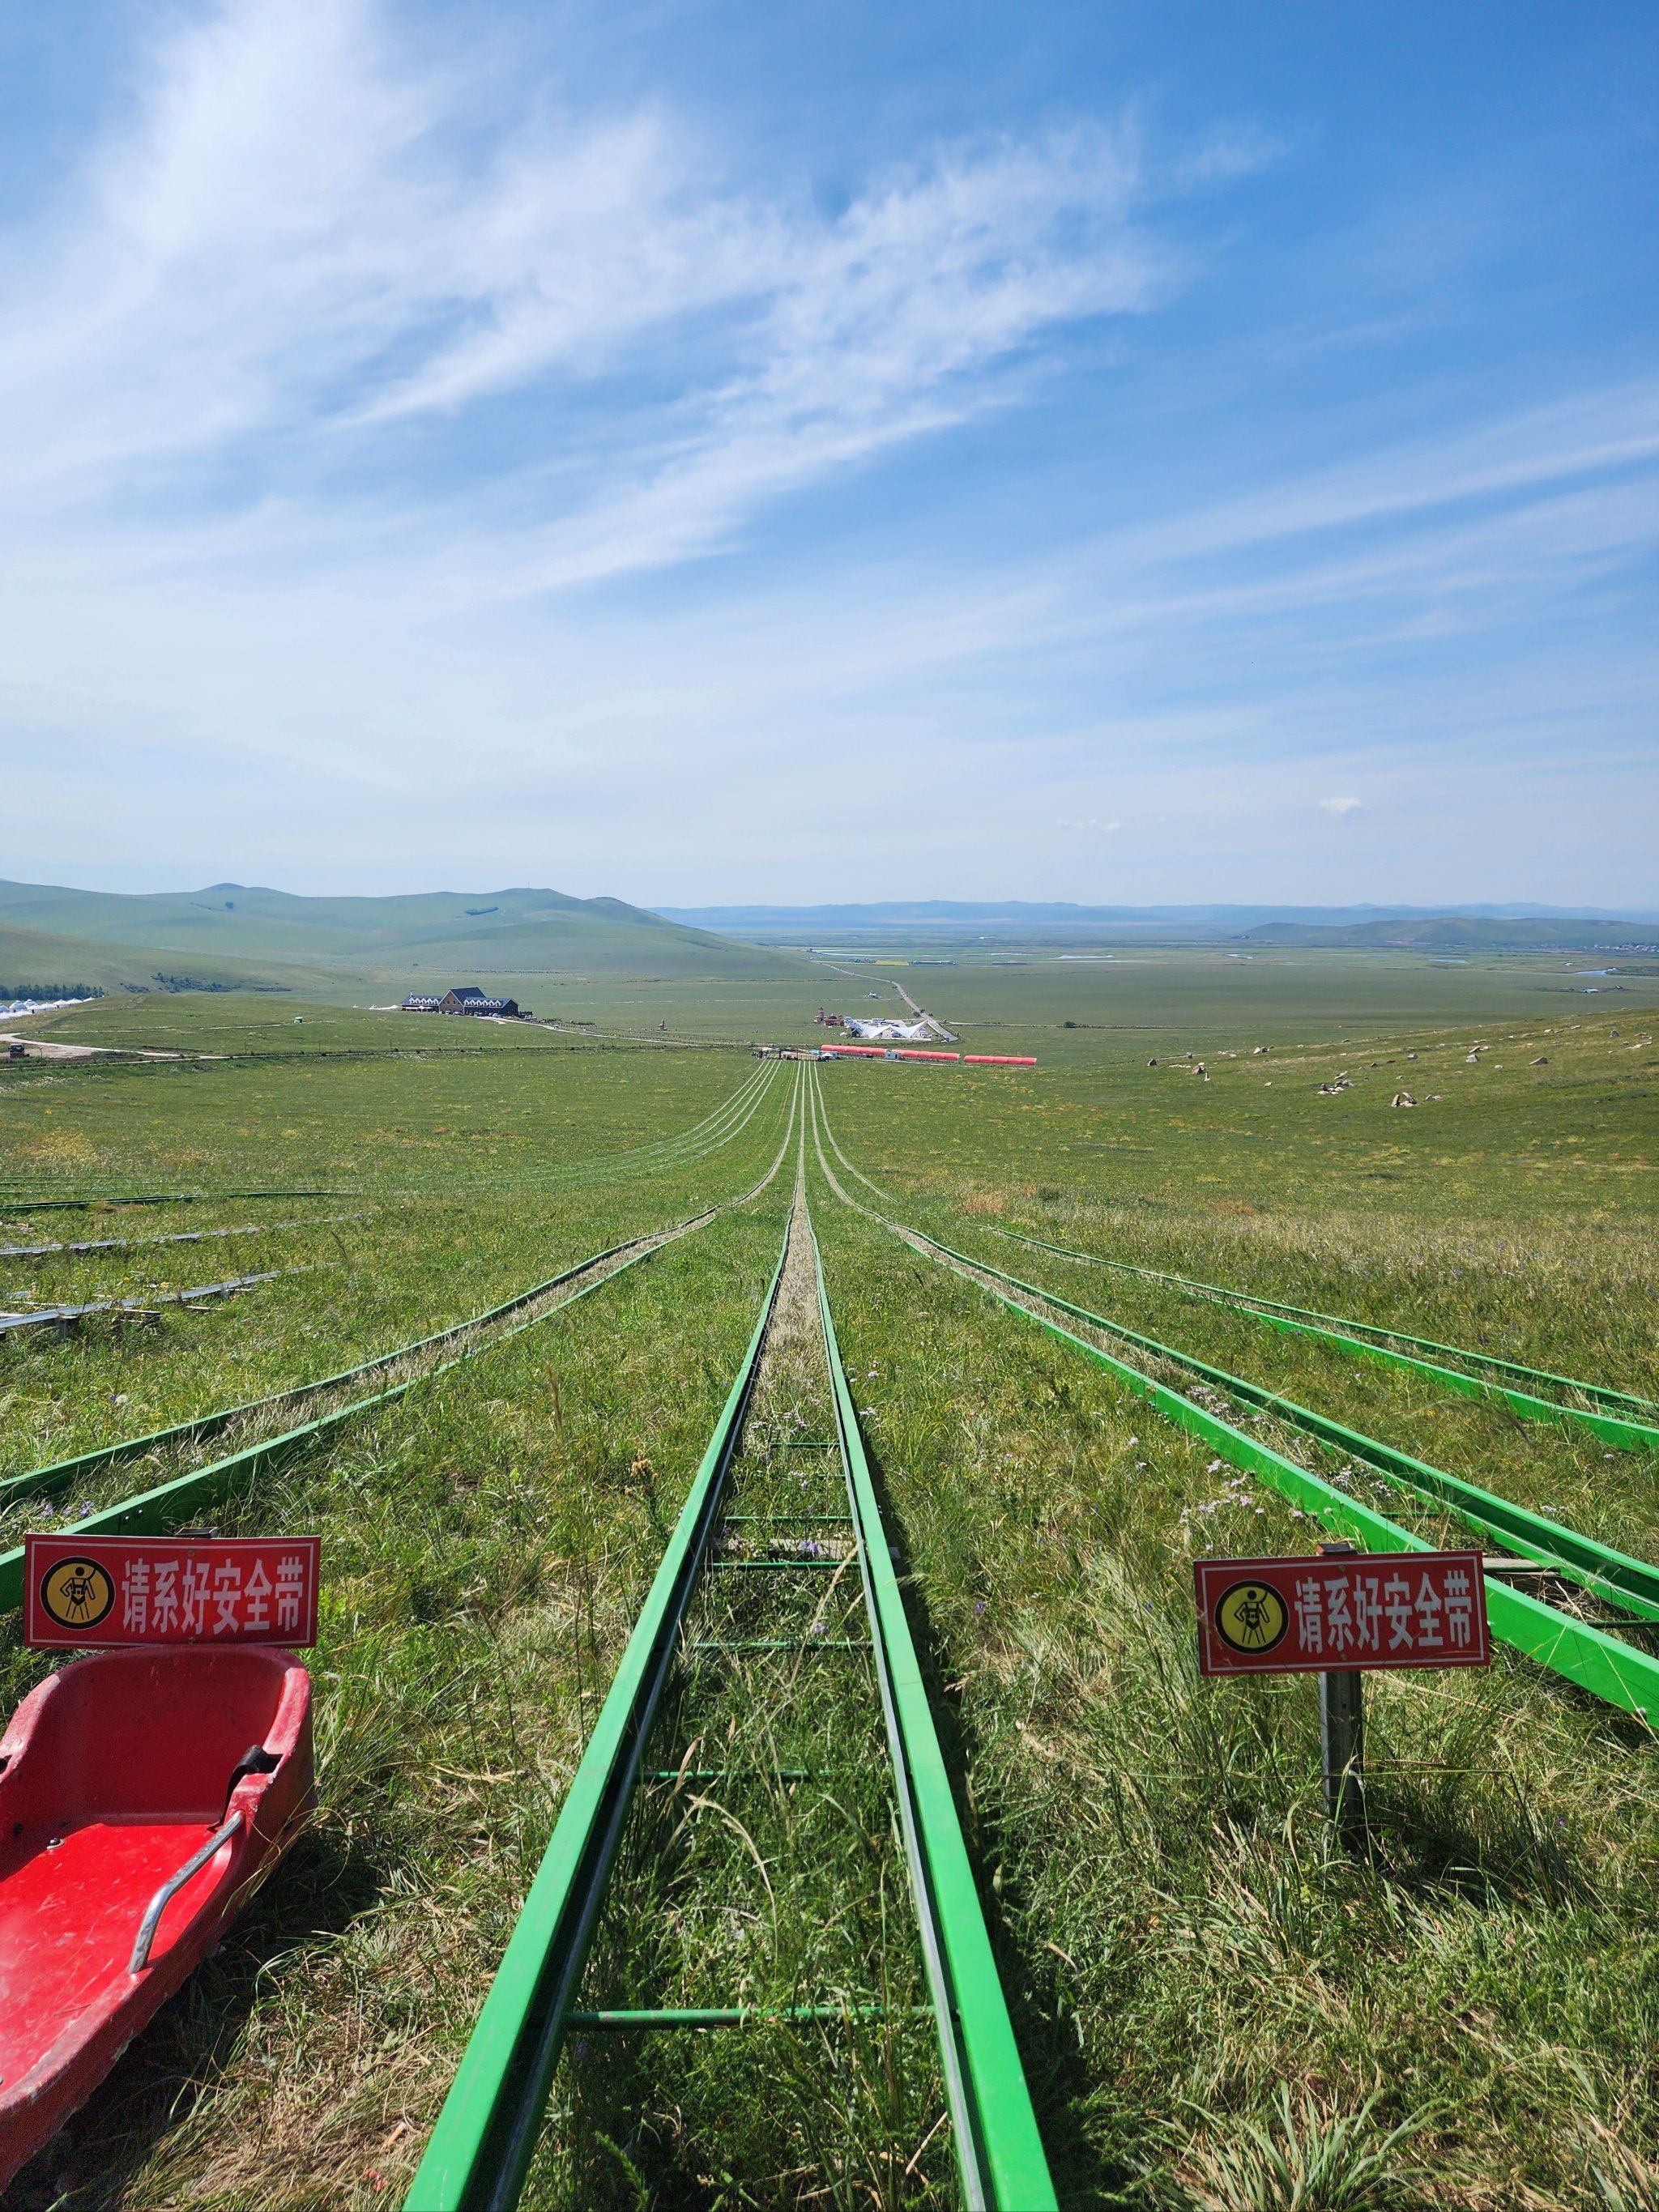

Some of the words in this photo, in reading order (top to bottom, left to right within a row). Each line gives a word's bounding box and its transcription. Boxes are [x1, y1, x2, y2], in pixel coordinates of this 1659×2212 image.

[122, 1556, 304, 1634] 请系好安全带
[1294, 1570, 1472, 1654] 请系好安全带
